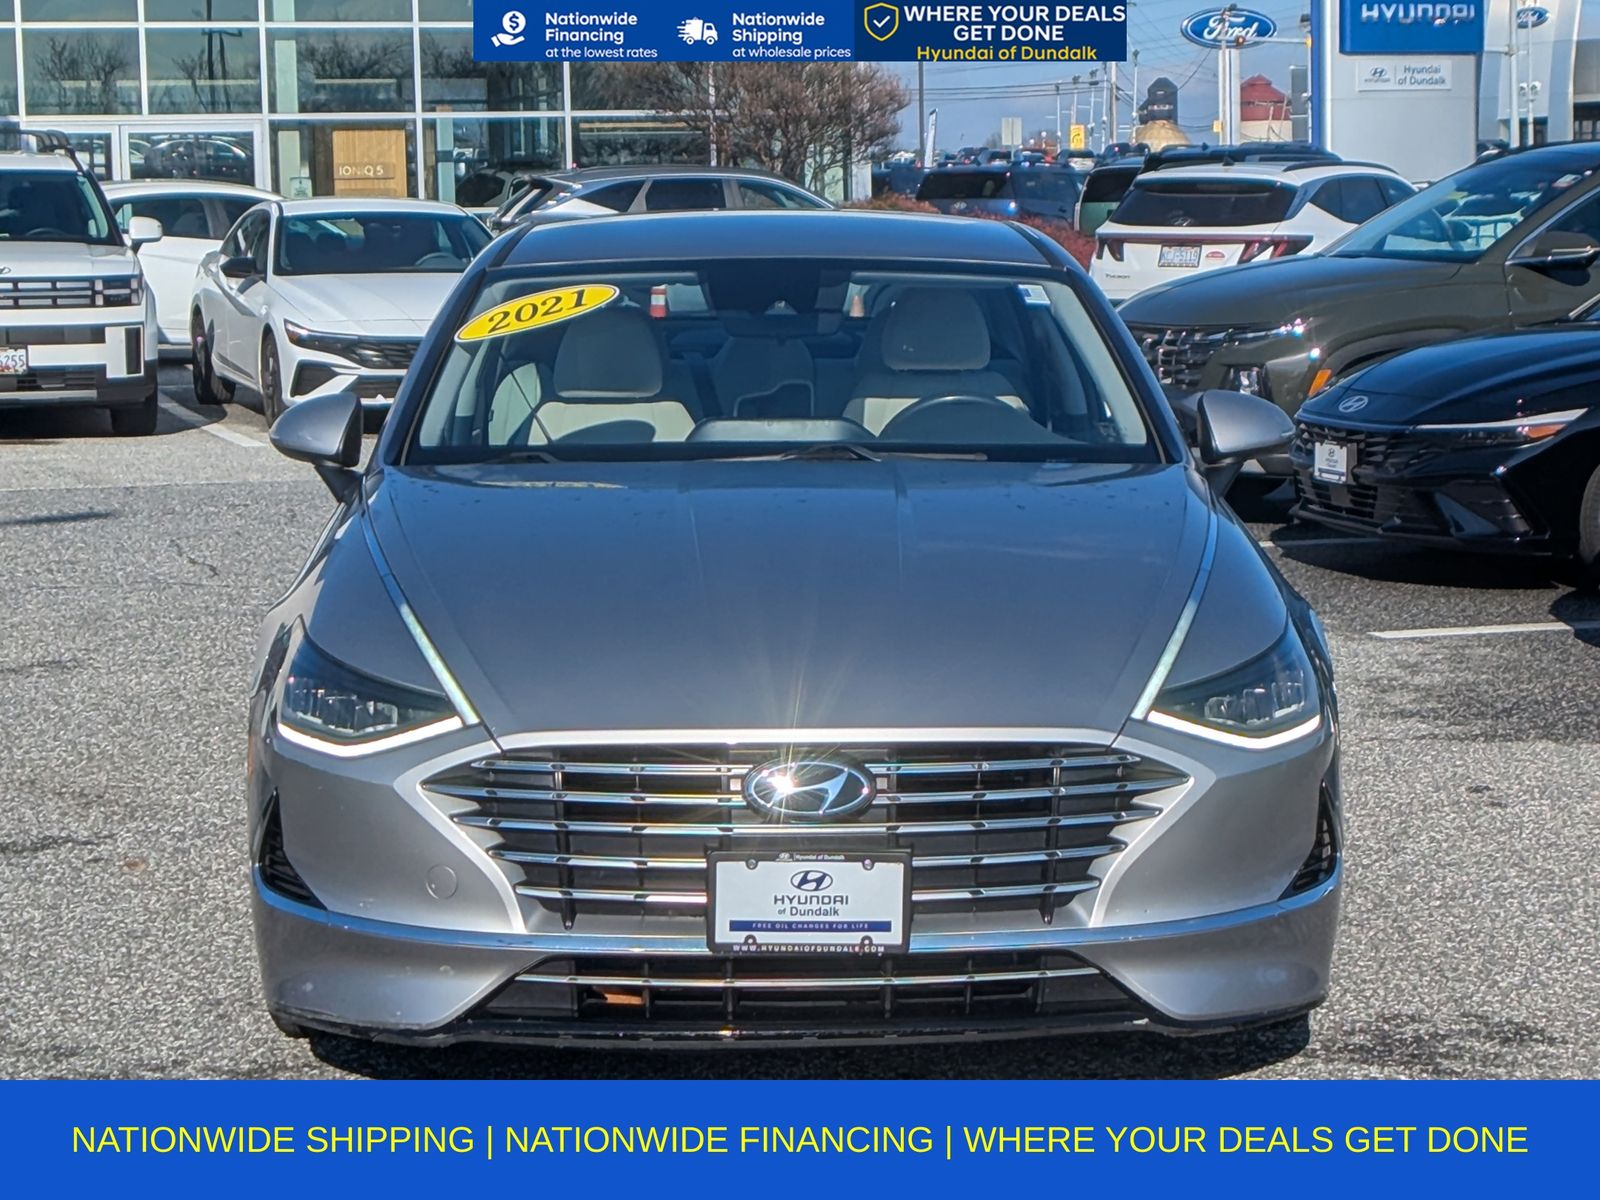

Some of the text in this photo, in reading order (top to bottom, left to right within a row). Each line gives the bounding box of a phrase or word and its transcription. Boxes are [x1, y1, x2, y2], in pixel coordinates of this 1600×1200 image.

[1361, 3, 1475, 23] HYUNDAI
[1403, 64, 1441, 74] Hyundai
[1398, 75, 1407, 85] of
[1409, 75, 1446, 85] Dundalk
[487, 288, 589, 334] 2021
[773, 895, 849, 905] HYUNDAI
[778, 906, 840, 917] of Dundalk
